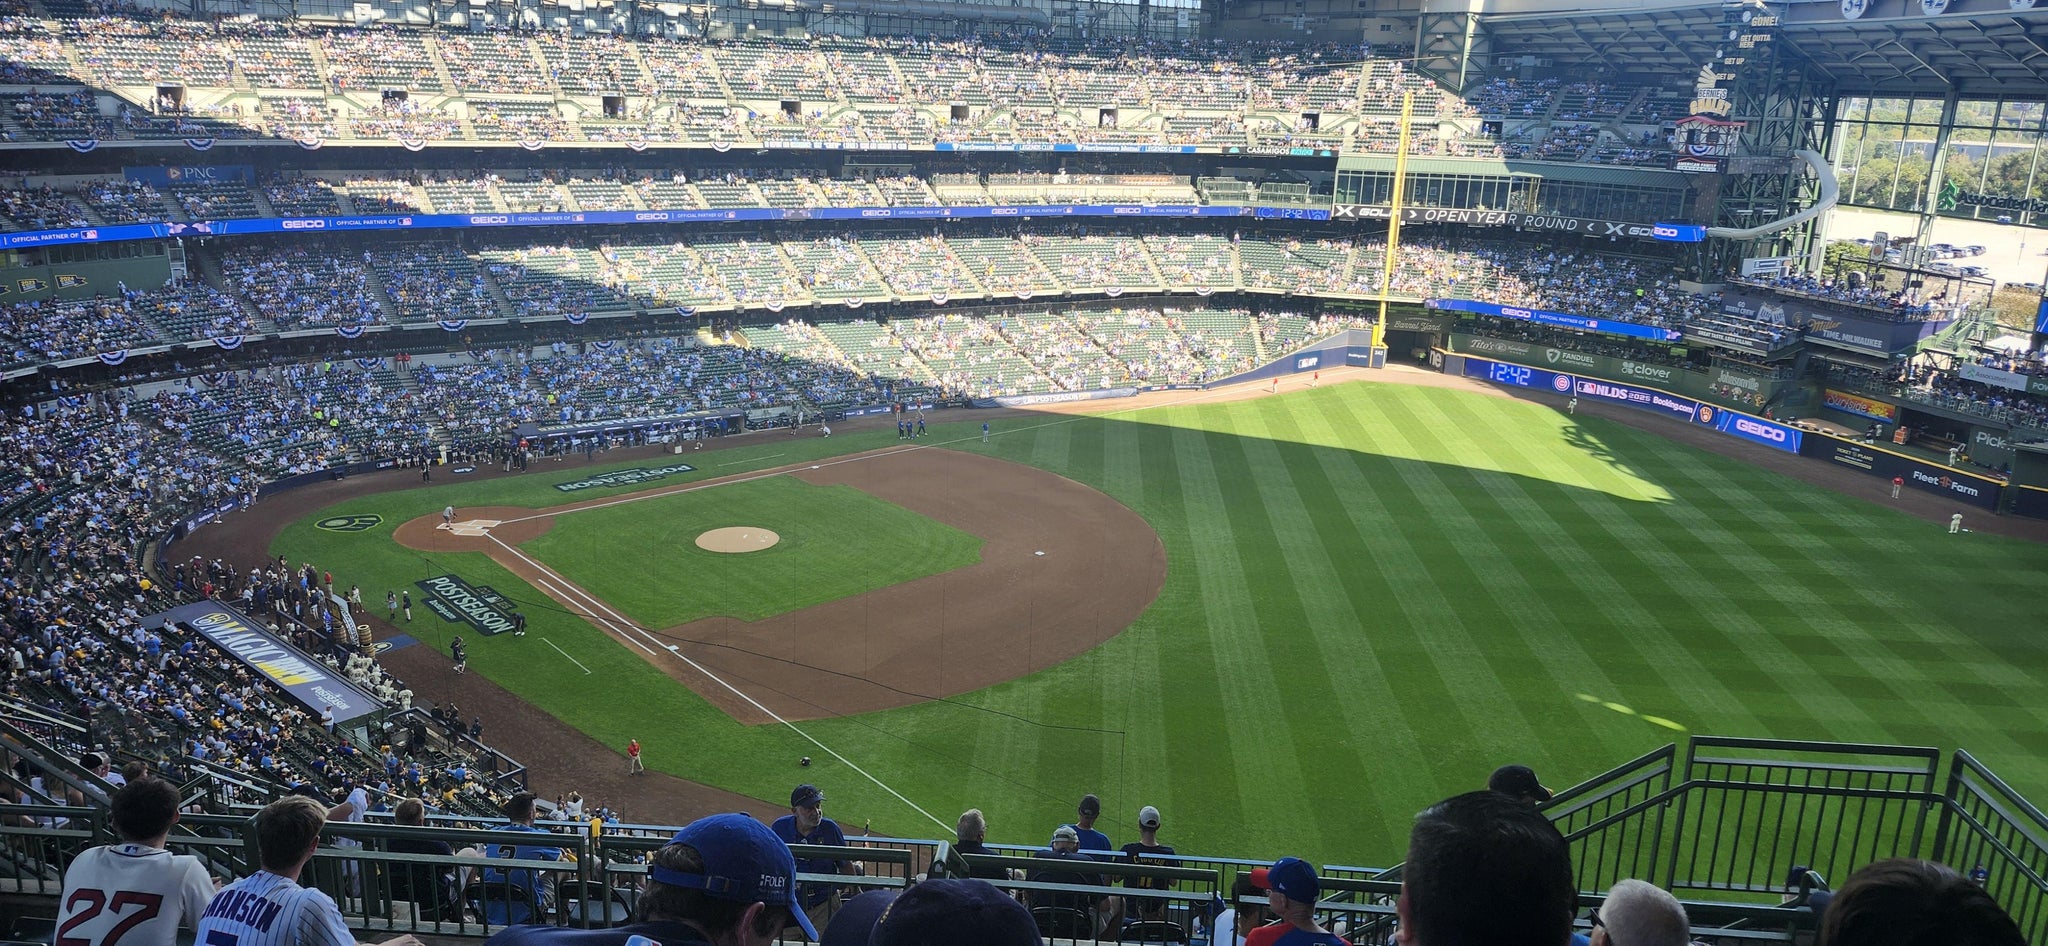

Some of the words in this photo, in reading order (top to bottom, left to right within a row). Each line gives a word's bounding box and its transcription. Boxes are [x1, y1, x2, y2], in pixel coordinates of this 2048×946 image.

[1751, 16, 1778, 26] GONE!
[1740, 34, 1752, 42] GET
[1698, 88, 1728, 99] BERNIE'S
[1689, 98, 1732, 117] CHALET
[1246, 147, 1290, 155] CASAMIGOS
[183, 167, 216, 178] PNC
[1958, 191, 2028, 211] Associated
[2030, 198, 2048, 213] Ba
[470, 216, 508, 224] GEICO
[862, 209, 891, 217] GEICO
[1281, 208, 1303, 218] 12:42
[1425, 210, 1470, 222] OPEN
[1476, 212, 1517, 225] YEAR
[1524, 216, 1578, 231] ROUND
[282, 219, 325, 229] GEICO
[12, 235, 39, 243] OFFICIAL
[1501, 308, 1532, 318] GEICO
[1539, 314, 1558, 322] OFFICIAL
[1558, 316, 1578, 324] PARTNER
[1394, 320, 1419, 330] Barrel
[1420, 322, 1442, 332] Yard
[1807, 318, 1842, 334] Miller
[1470, 338, 1495, 350] Tito's
[1823, 330, 1841, 341] TIME,
[1842, 333, 1883, 348] MILWAUKEE
[1562, 352, 1594, 364] FANDUEL
[1489, 362, 1531, 386] 12:42
[1634, 363, 1672, 379] clover
[1975, 372, 2006, 384] Associated
[1718, 370, 1760, 391] Johnsonville
[1596, 384, 1628, 400] NLDS
[1628, 392, 1652, 402] 2025
[1652, 396, 1694, 414] Booking.com
[1826, 394, 1868, 412] Surfside
[1736, 418, 1786, 442] GEICO
[558, 464, 692, 492] POSTSEASON
[1912, 470, 1940, 486] Fleet
[1950, 481, 1978, 497] Farm
[426, 576, 515, 634] POSTSEASON
[202, 621, 289, 665] MAGIC
[765, 875, 787, 887] FOLEY
[55, 887, 164, 946] 27
